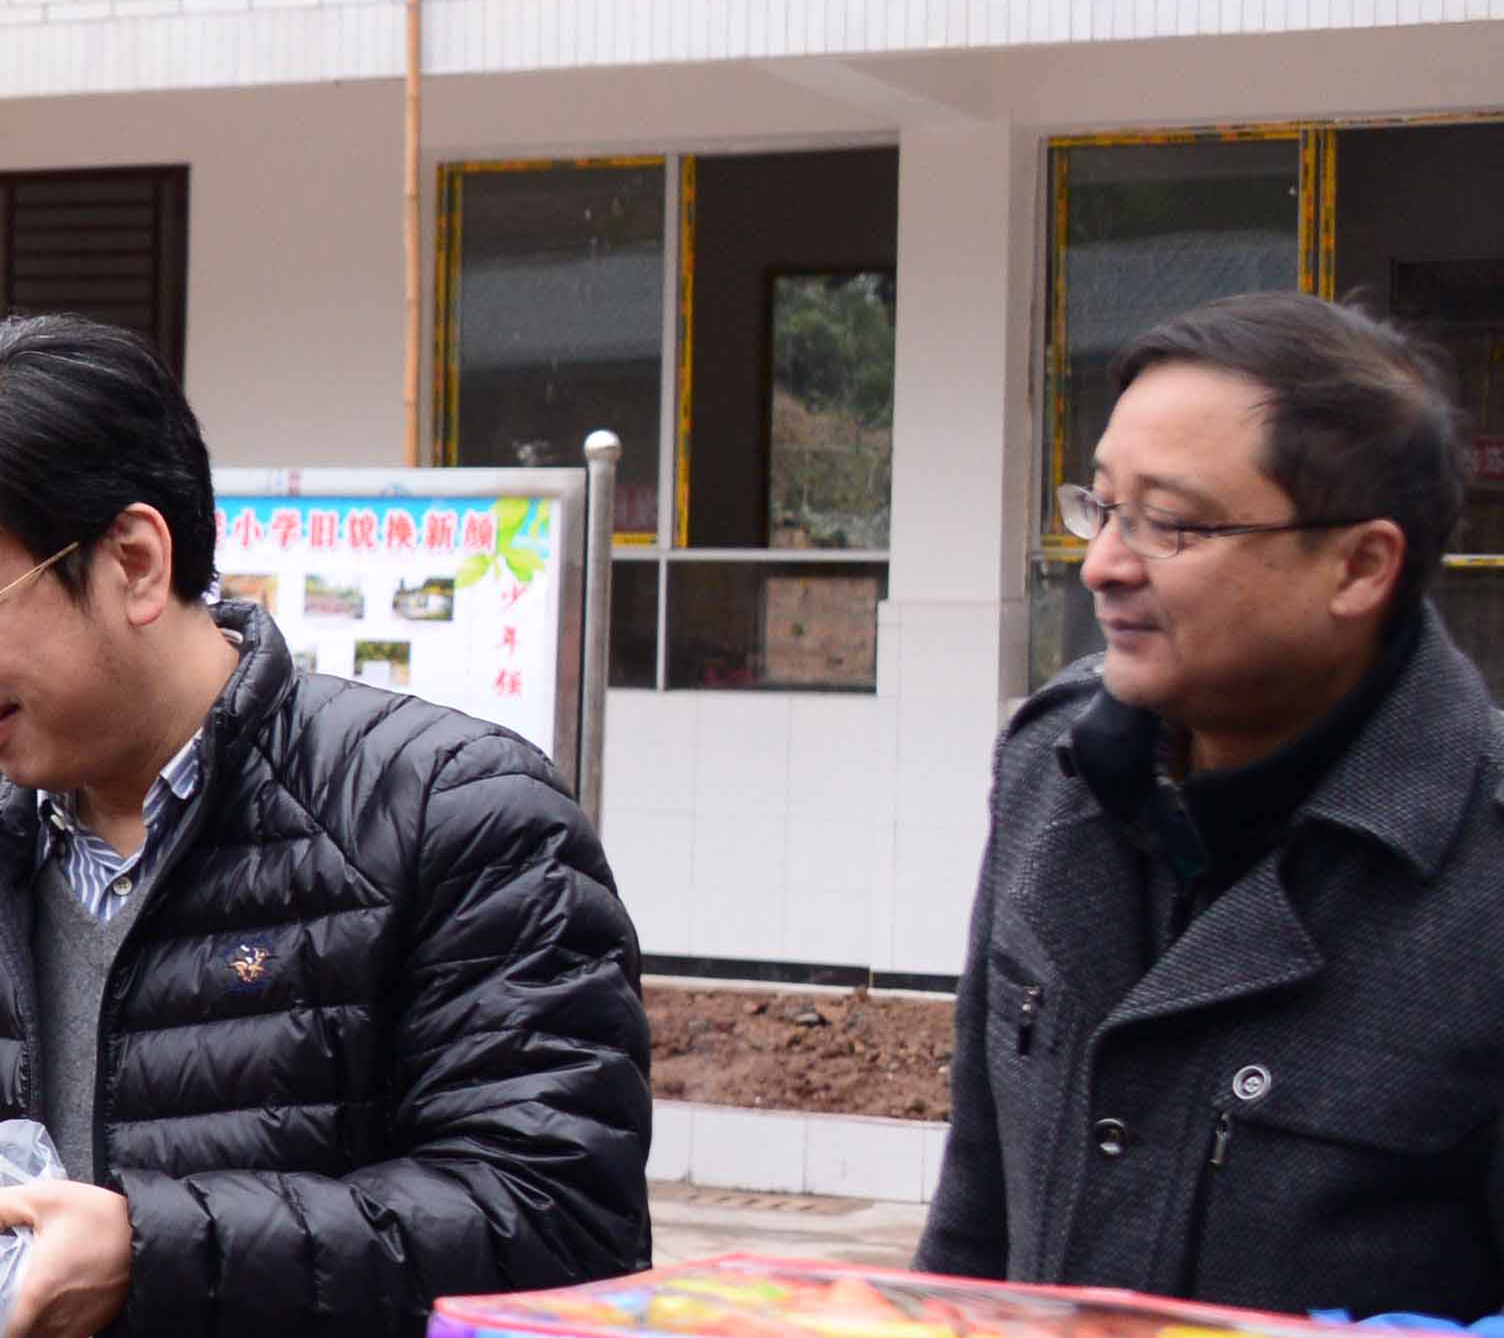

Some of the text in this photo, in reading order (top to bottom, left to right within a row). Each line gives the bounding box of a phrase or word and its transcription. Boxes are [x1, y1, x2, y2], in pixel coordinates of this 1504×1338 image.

[214, 507, 496, 550] 小学旧貌换新颜
